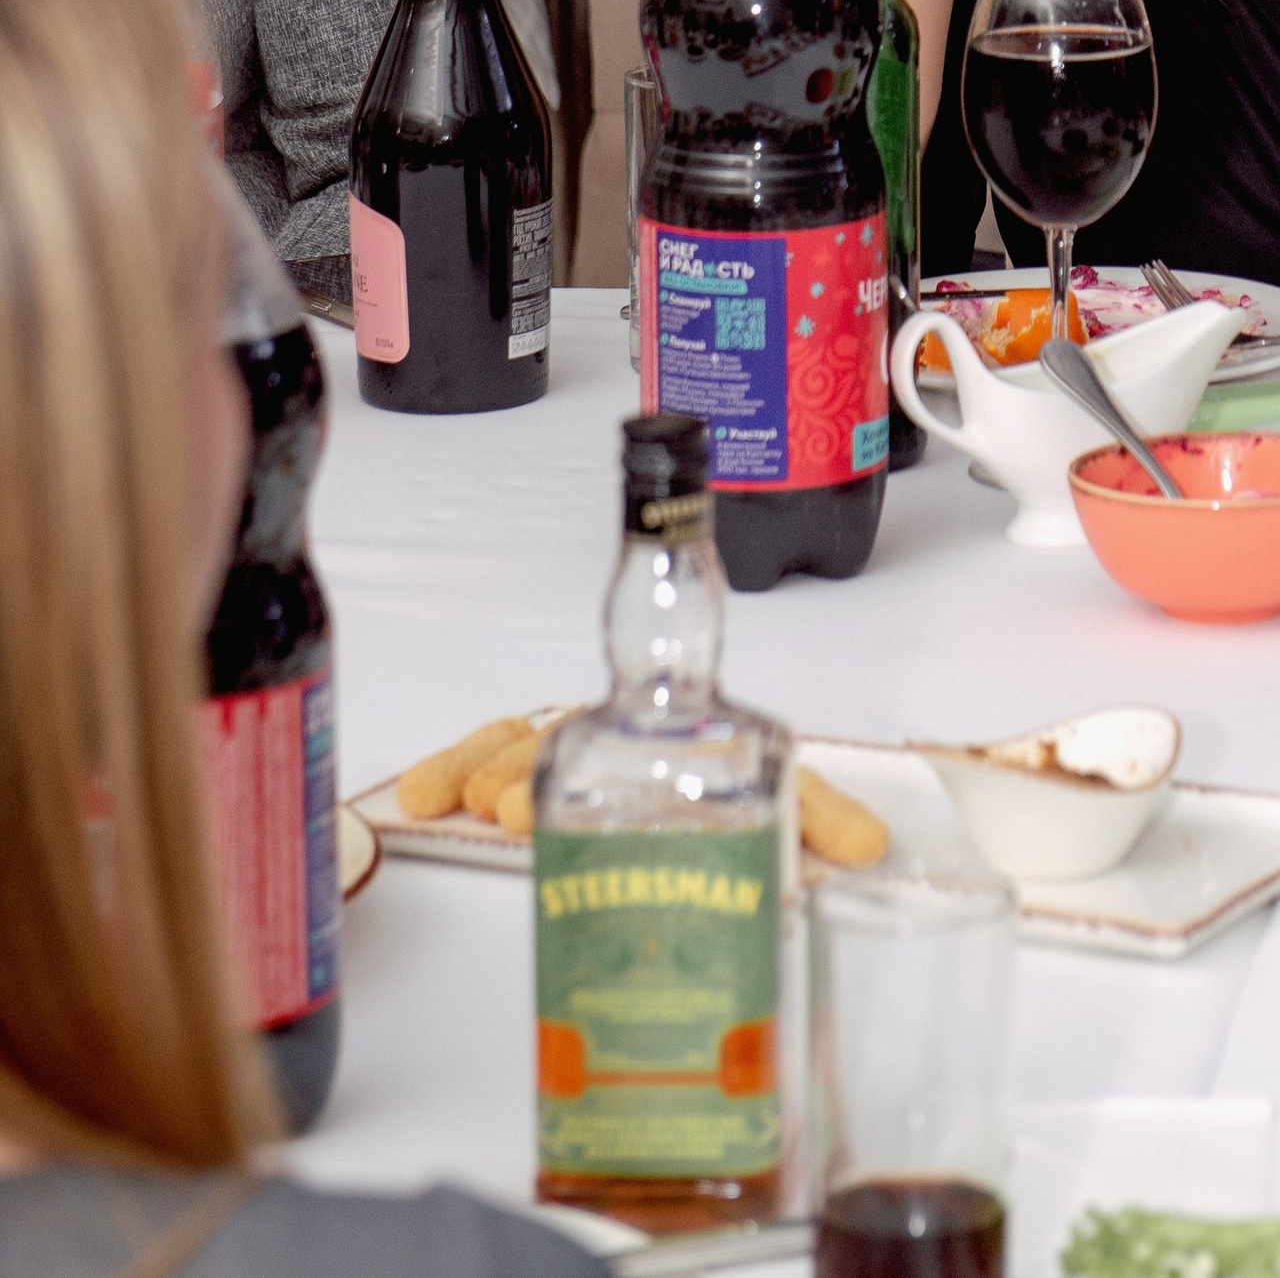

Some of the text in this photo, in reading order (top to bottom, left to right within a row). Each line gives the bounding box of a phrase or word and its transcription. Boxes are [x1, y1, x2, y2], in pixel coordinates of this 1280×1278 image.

[659, 238, 699, 259] СНЕГ
[729, 427, 777, 442] Участвуй
[539, 866, 764, 921] STEERSMAN
